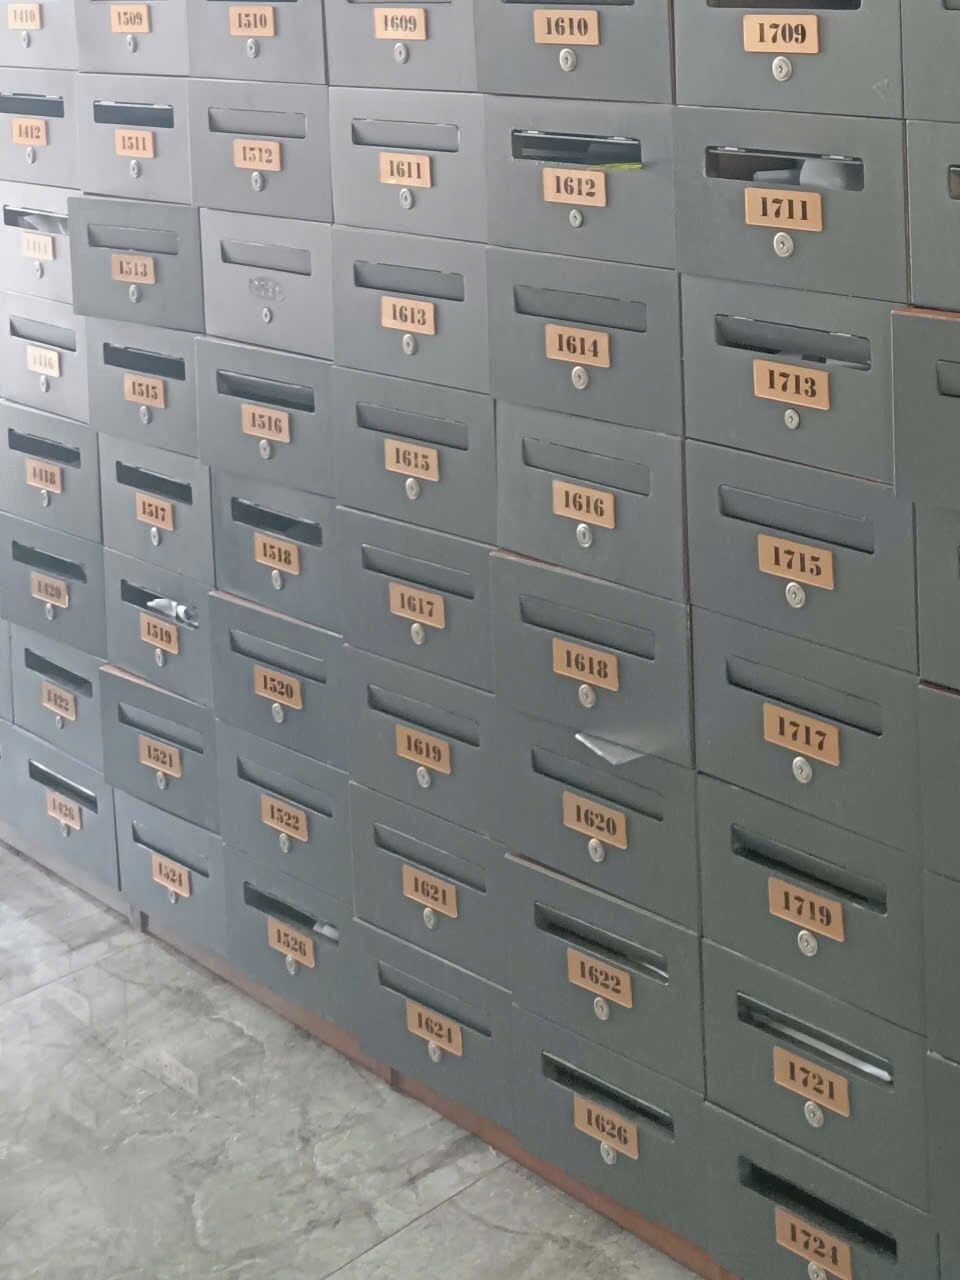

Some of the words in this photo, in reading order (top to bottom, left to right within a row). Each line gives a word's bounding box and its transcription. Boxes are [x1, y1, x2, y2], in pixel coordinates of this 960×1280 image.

[117, 11, 143, 26] 1509
[238, 13, 268, 29] 1510
[384, 14, 417, 32] 1609
[546, 17, 589, 36] 1610
[759, 22, 807, 44] 1709
[18, 124, 41, 139] 1412
[122, 136, 147, 152] 1511
[242, 145, 273, 163] 1512
[390, 160, 422, 180] 1611
[555, 175, 596, 196] 1612
[761, 197, 809, 221] 1711
[119, 260, 148, 278] 1513
[392, 304, 427, 326] 1613
[558, 334, 599, 358] 1614
[132, 381, 158, 400] 1515
[768, 369, 817, 398] 1713
[251, 412, 283, 434] 1516
[395, 447, 431, 472] 1615
[33, 466, 56, 485] 1418
[142, 501, 166, 522] 1517
[564, 490, 605, 517] 1616
[263, 542, 292, 566] 1518
[774, 546, 822, 577] 1715
[400, 593, 434, 618] 1617
[146, 622, 172, 645] 1519
[566, 650, 609, 679] 1618
[263, 674, 294, 699] 1520
[46, 688, 69, 712] 1422
[779, 716, 827, 751] 1717
[147, 745, 173, 768] 1521
[406, 734, 442, 763] 1619
[52, 798, 75, 822] 1426
[270, 804, 299, 831] 1522
[576, 804, 617, 836] 1620
[414, 877, 447, 906] 1621
[784, 891, 832, 927] 1719
[277, 929, 307, 957] 1526
[579, 960, 621, 993] 1622
[789, 1061, 835, 1100] 1721
[587, 1108, 628, 1147] 1626
[790, 1223, 839, 1266] 1724
